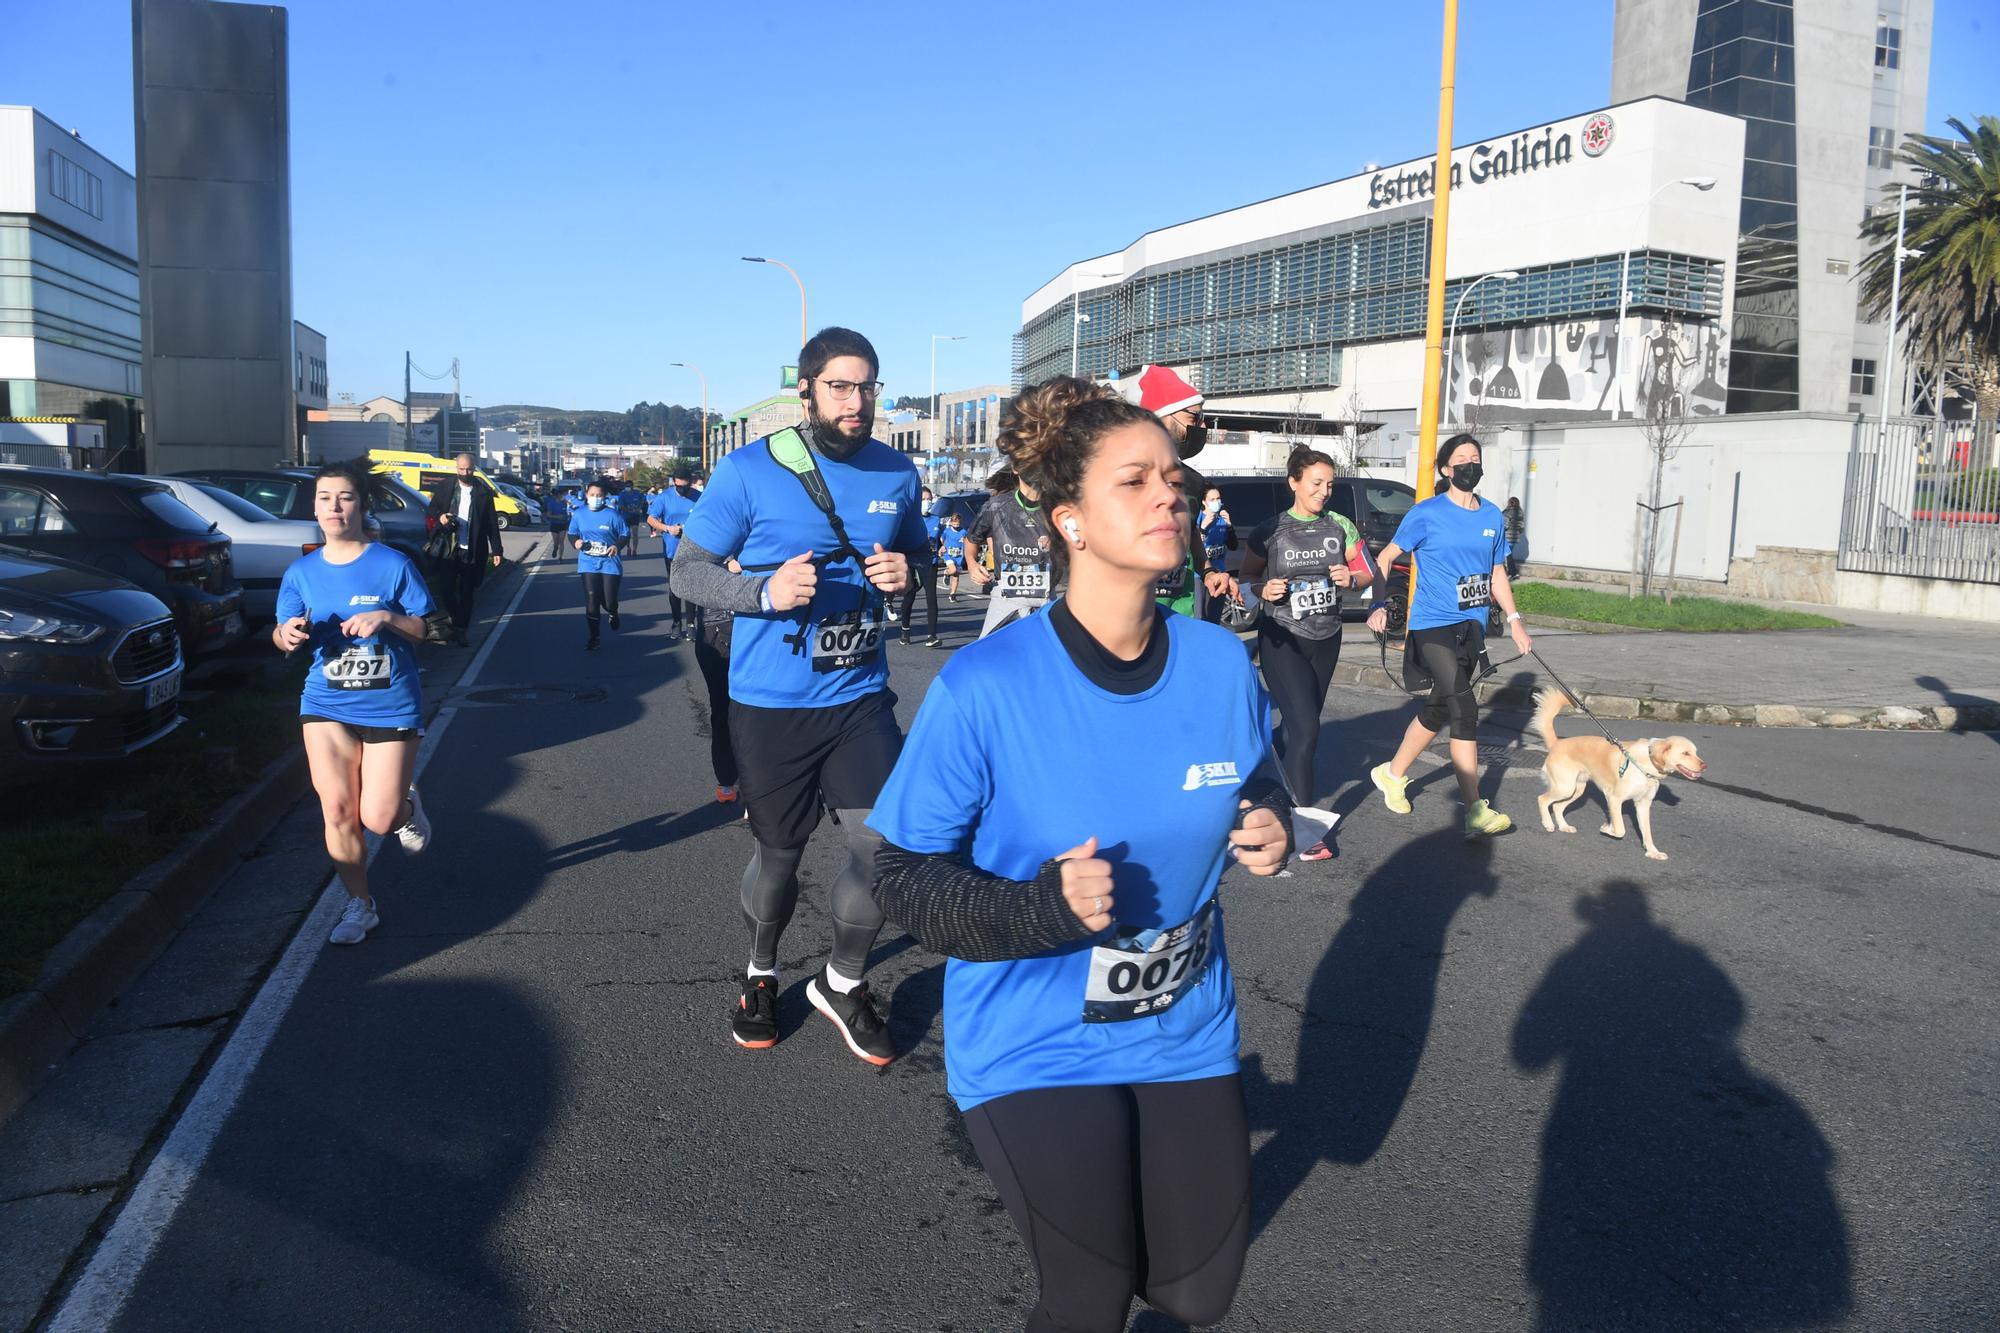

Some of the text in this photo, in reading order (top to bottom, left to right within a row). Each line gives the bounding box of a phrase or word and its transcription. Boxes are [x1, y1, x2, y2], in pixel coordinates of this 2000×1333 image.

[1367, 159, 1463, 210] Estrela
[1470, 127, 1572, 184] Galicia
[1490, 385, 1519, 397] 1906
[1003, 543, 1039, 556] Orona
[1284, 549, 1327, 560] Orona
[1007, 574, 1044, 587] 0133
[1297, 590, 1332, 607] 0136
[1461, 583, 1488, 599] 0048
[820, 627, 878, 652] 0076
[329, 659, 383, 676] 0797
[1207, 761, 1238, 778] 5KM
